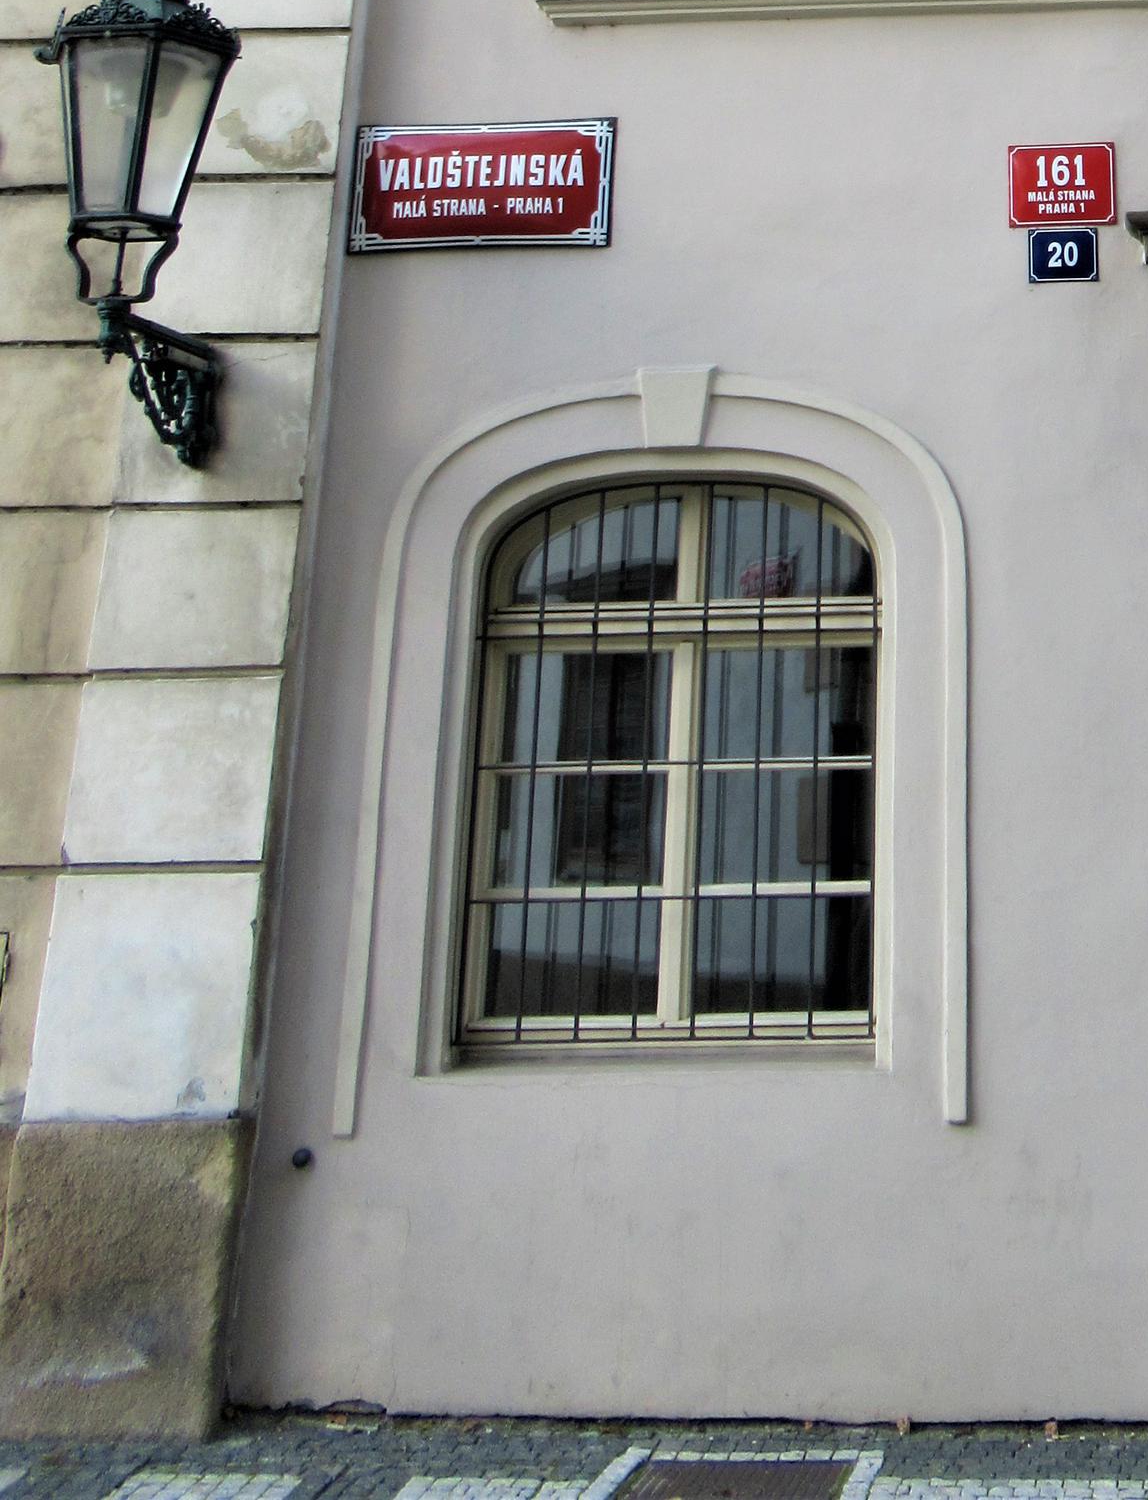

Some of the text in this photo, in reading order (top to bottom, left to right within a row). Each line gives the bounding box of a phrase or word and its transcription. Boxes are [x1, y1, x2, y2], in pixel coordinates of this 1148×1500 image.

[379, 148, 586, 192] VALDŠTEJNSKÁ
[1036, 154, 1086, 188] 161
[392, 194, 428, 219] MALÁ
[432, 197, 487, 217] STRANA
[506, 196, 554, 215] PRAHA
[556, 196, 564, 214] 1
[1027, 188, 1096, 203] MALÁ STRANA
[1038, 202, 1085, 214] PRAHA 1
[1047, 240, 1079, 268] 20
